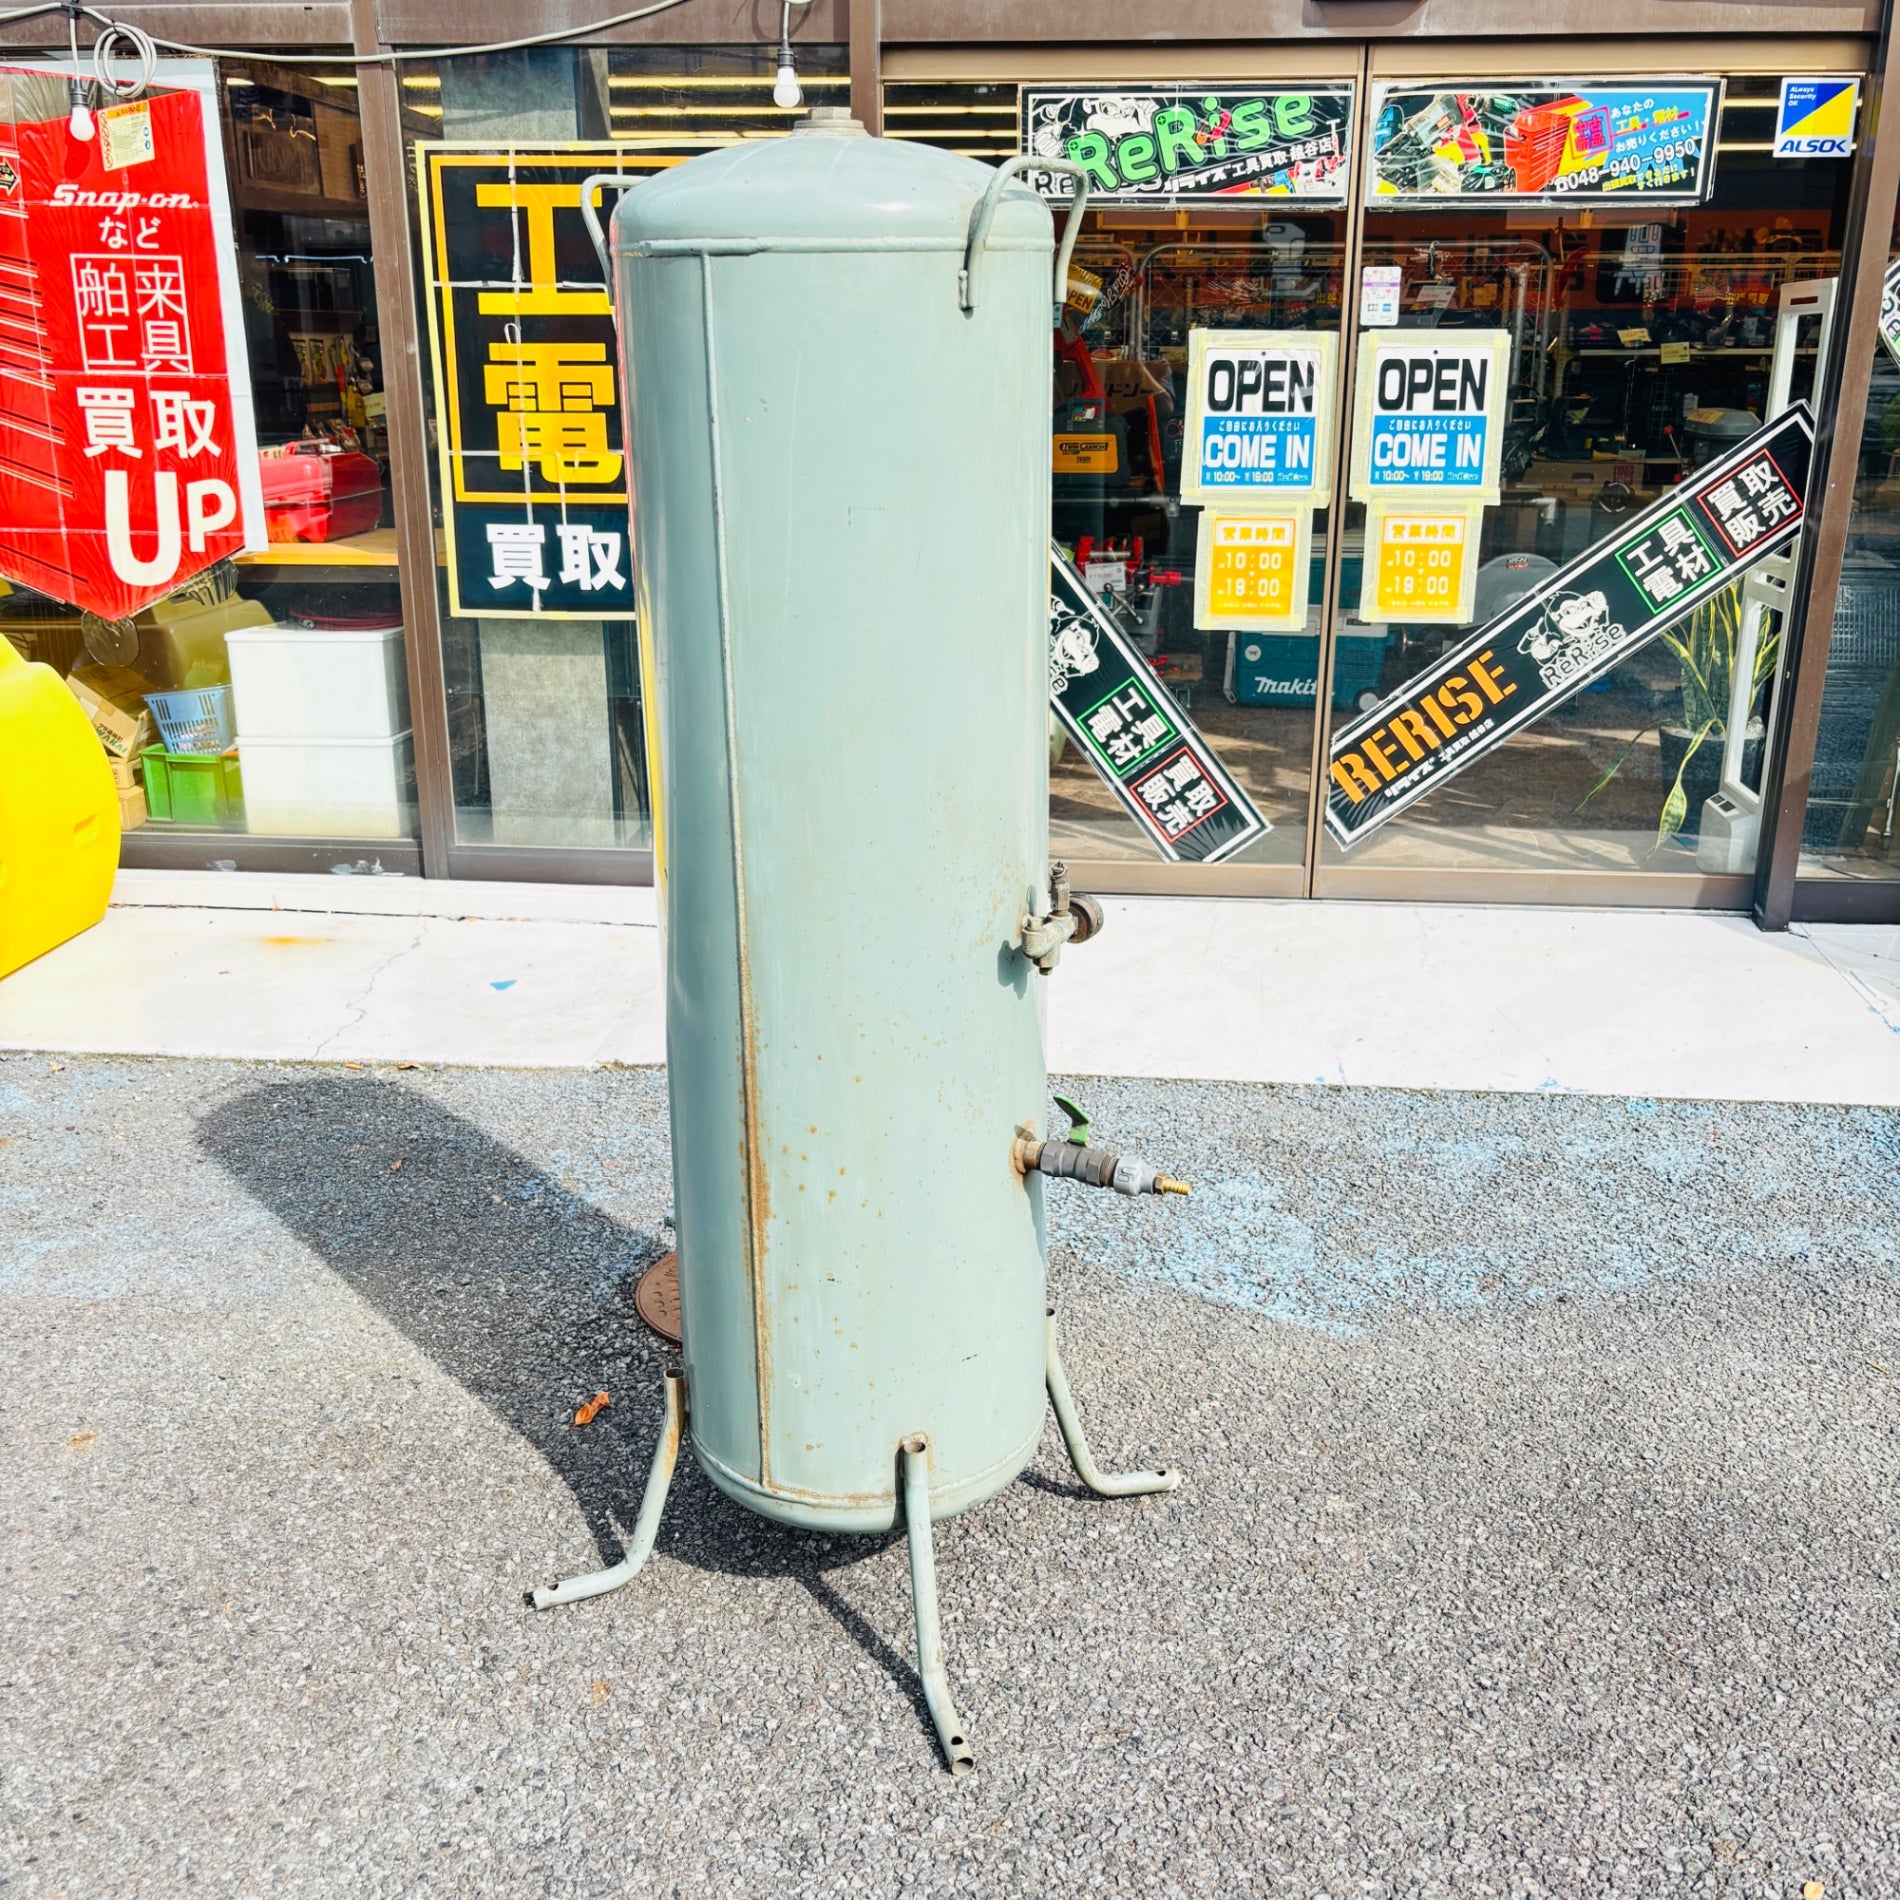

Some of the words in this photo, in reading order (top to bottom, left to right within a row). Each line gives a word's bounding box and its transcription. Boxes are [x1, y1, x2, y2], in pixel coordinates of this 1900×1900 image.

[1611, 98, 1655, 119] あなたの
[1067, 95, 1314, 190] ReRise
[1779, 139, 1847, 153] ALSOK
[50, 184, 193, 211] Snap-on
[99, 216, 160, 250] など
[1067, 290, 1093, 310] PEN
[86, 321, 190, 373] 工具
[1207, 359, 1315, 413] OPEN
[1377, 358, 1488, 411] OPEN
[76, 387, 222, 460] 買取
[1204, 434, 1276, 469] COME
[1285, 434, 1312, 469] IN
[1373, 433, 1448, 468] COME
[1454, 433, 1483, 468] IN
[1706, 460, 1780, 523] 買取
[1625, 516, 1693, 575] 工具
[1723, 493, 1797, 550] 販売
[486, 522, 627, 592] 買取
[1225, 551, 1282, 570] 10:00
[1394, 549, 1452, 567] 10:00
[1642, 543, 1711, 604] 電材
[1330, 650, 1518, 805] RERISE
[1137, 773, 1194, 836] 販売
[1162, 754, 1218, 817] 買取
